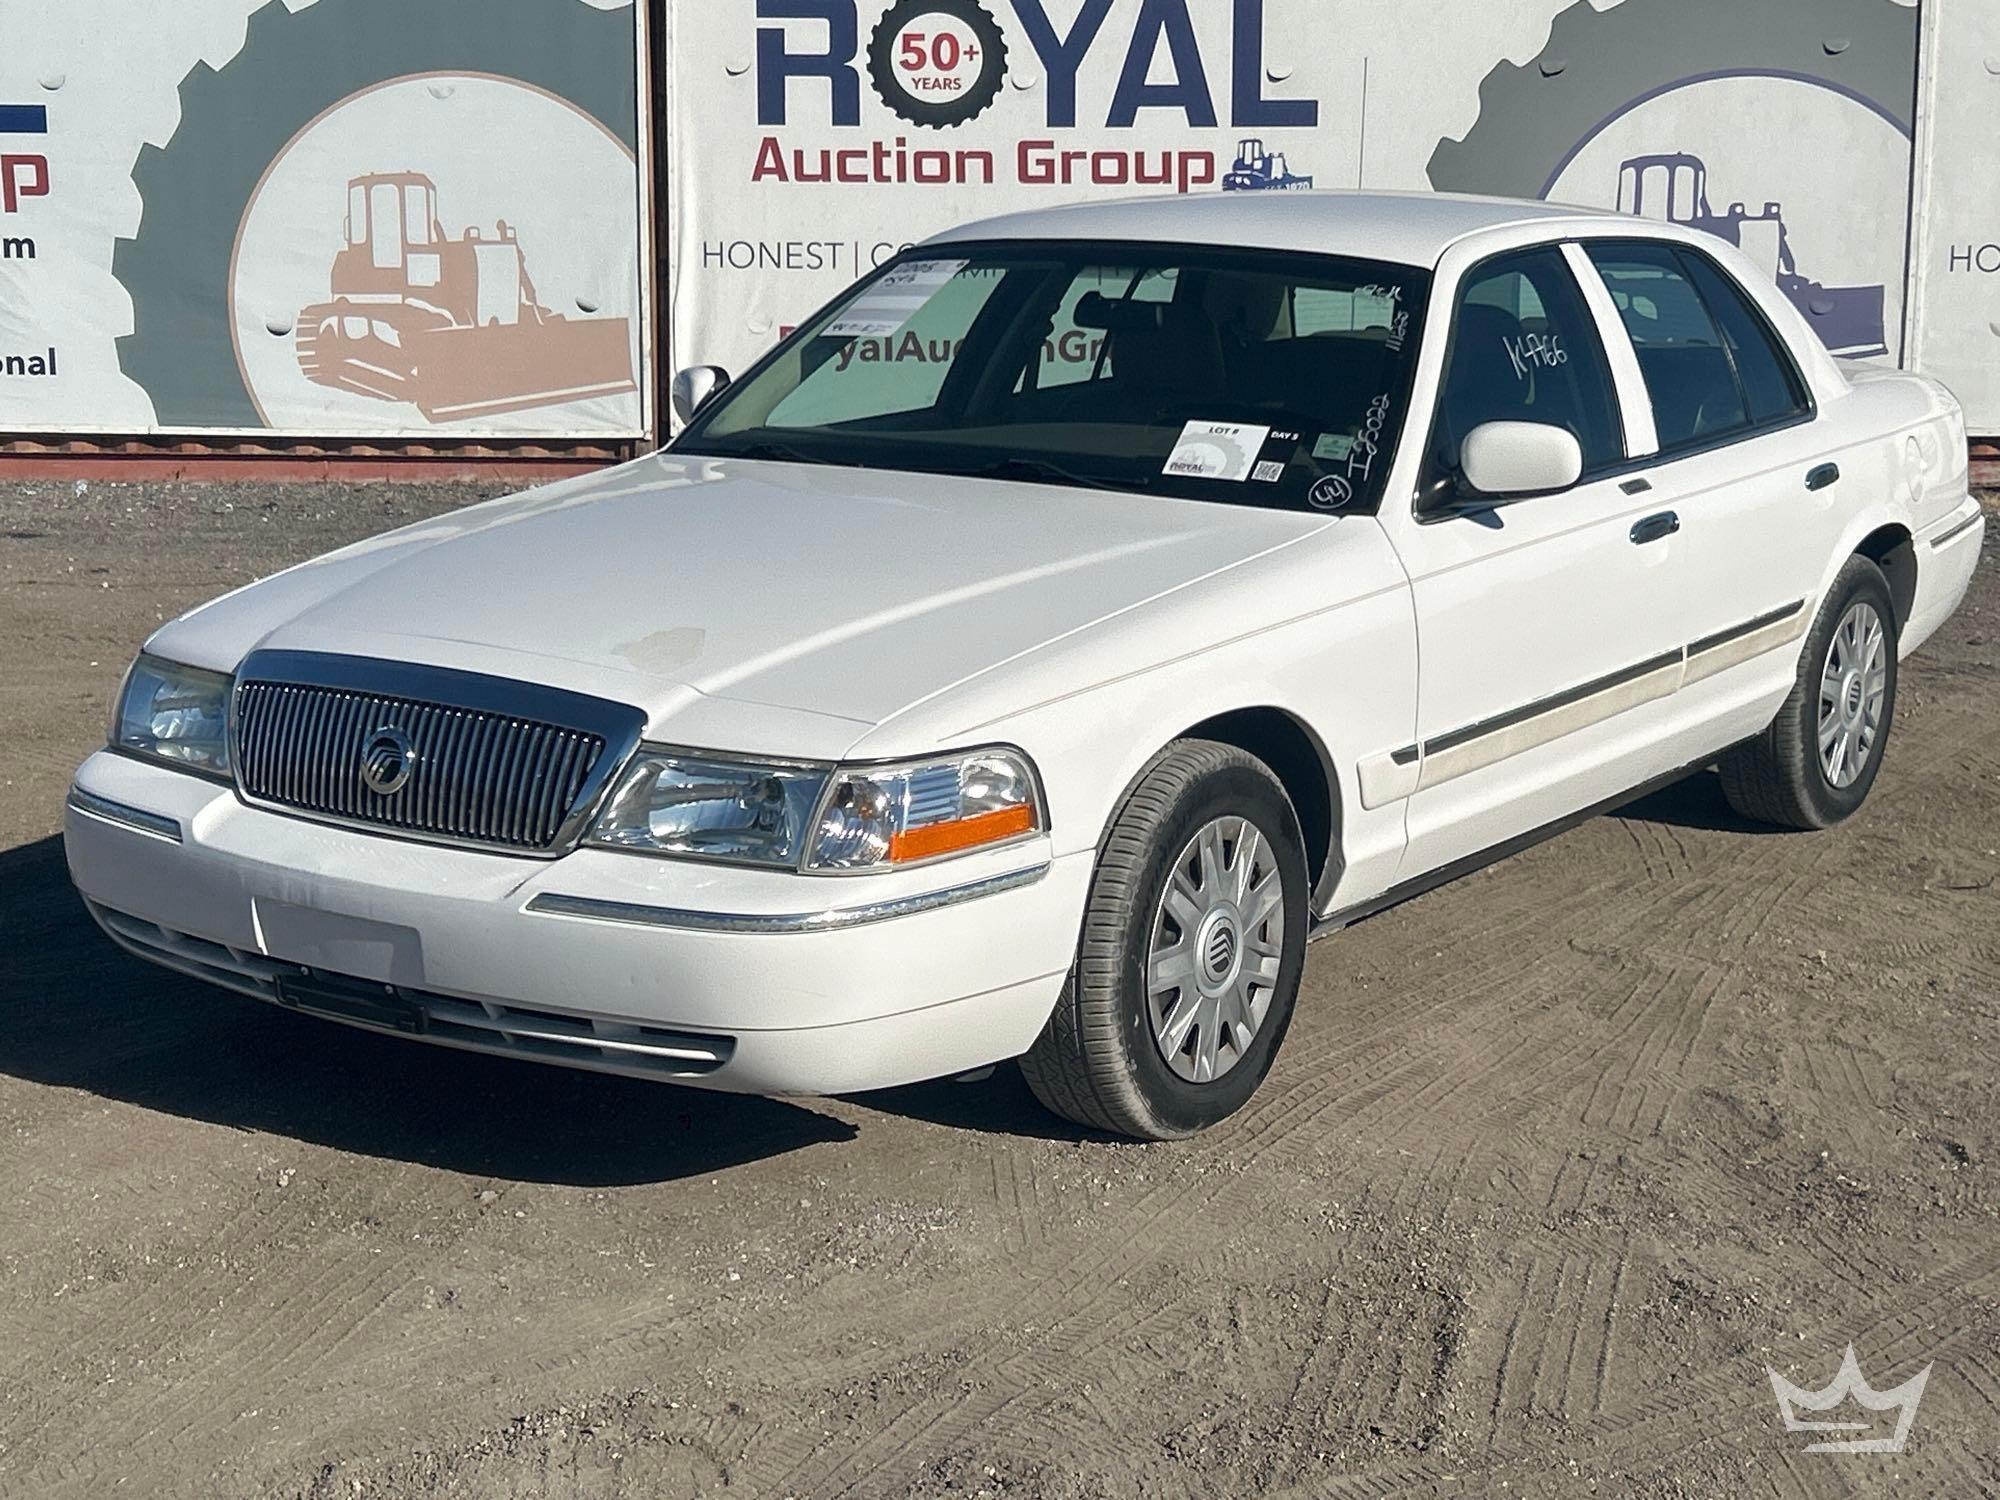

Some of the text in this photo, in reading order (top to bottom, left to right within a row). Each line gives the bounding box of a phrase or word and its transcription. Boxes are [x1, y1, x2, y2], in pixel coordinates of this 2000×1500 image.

[900, 32, 980, 72] 50+
[911, 76, 962, 92] YEARS
[751, 136, 1216, 193] Auction Group
[3, 237, 36, 259] m
[702, 240, 845, 271] HONEST
[0, 347, 56, 376] nal
[1208, 426, 1231, 435] LOT
[1270, 430, 1292, 440] DAY
